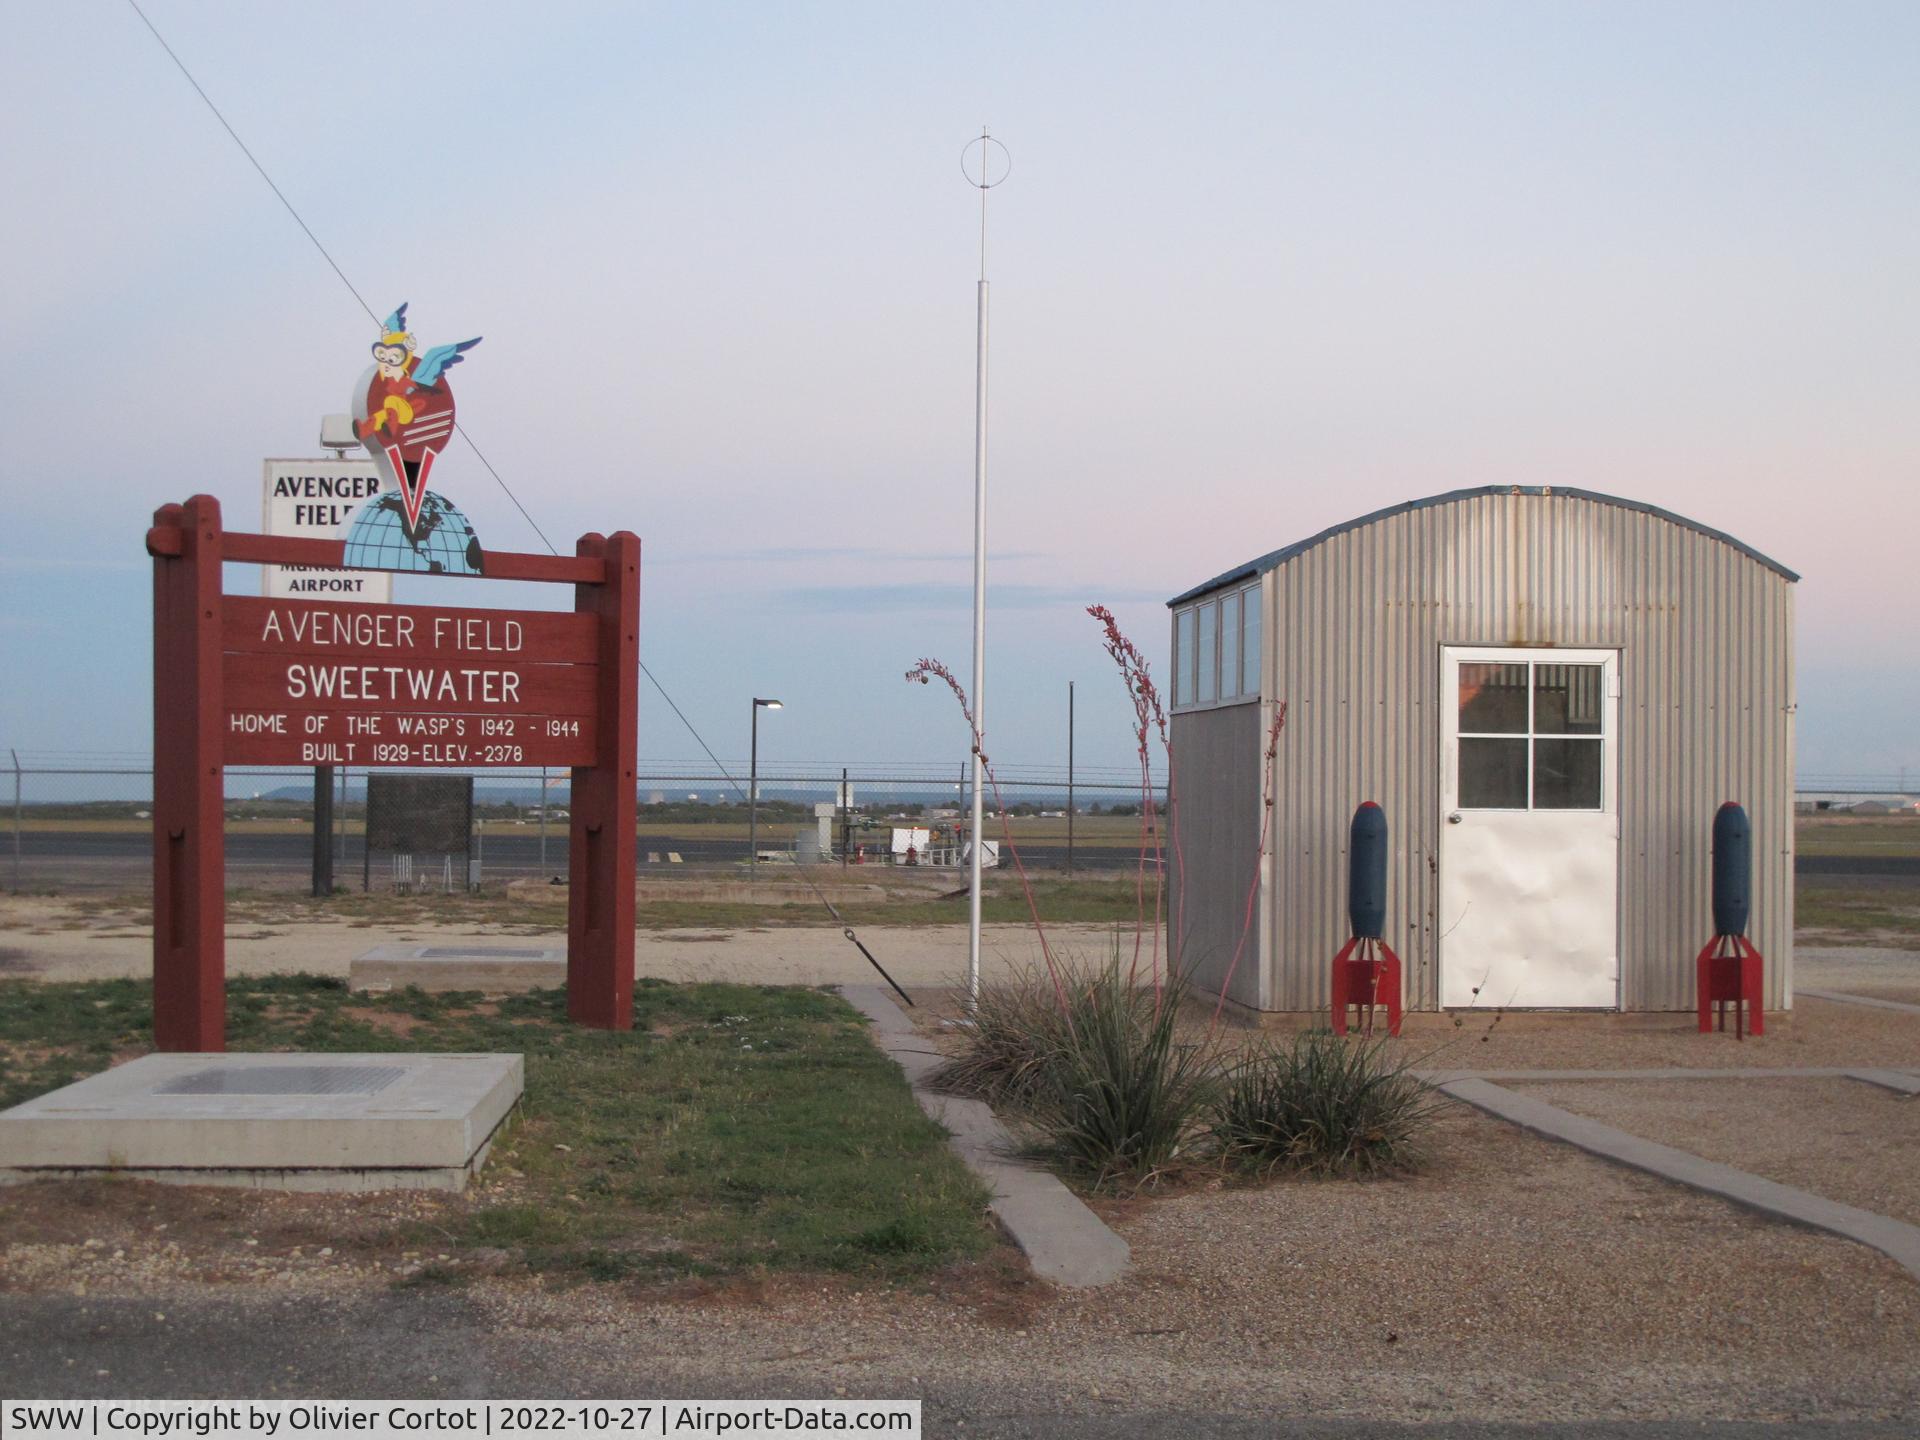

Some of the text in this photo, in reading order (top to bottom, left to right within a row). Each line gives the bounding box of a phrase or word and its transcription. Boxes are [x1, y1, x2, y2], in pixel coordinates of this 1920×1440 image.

[273, 476, 380, 498] AVENGER
[289, 579, 364, 592] AIRPORT
[262, 609, 522, 652] AVENGER FIELD
[287, 664, 520, 703] SWEETWATER
[231, 713, 288, 734] HOME
[304, 715, 329, 734] OF
[346, 716, 382, 736] THE
[397, 717, 465, 737] WASP'S
[481, 718, 515, 737] 1942
[546, 719, 579, 737] 1944
[302, 742, 356, 762] BUILT
